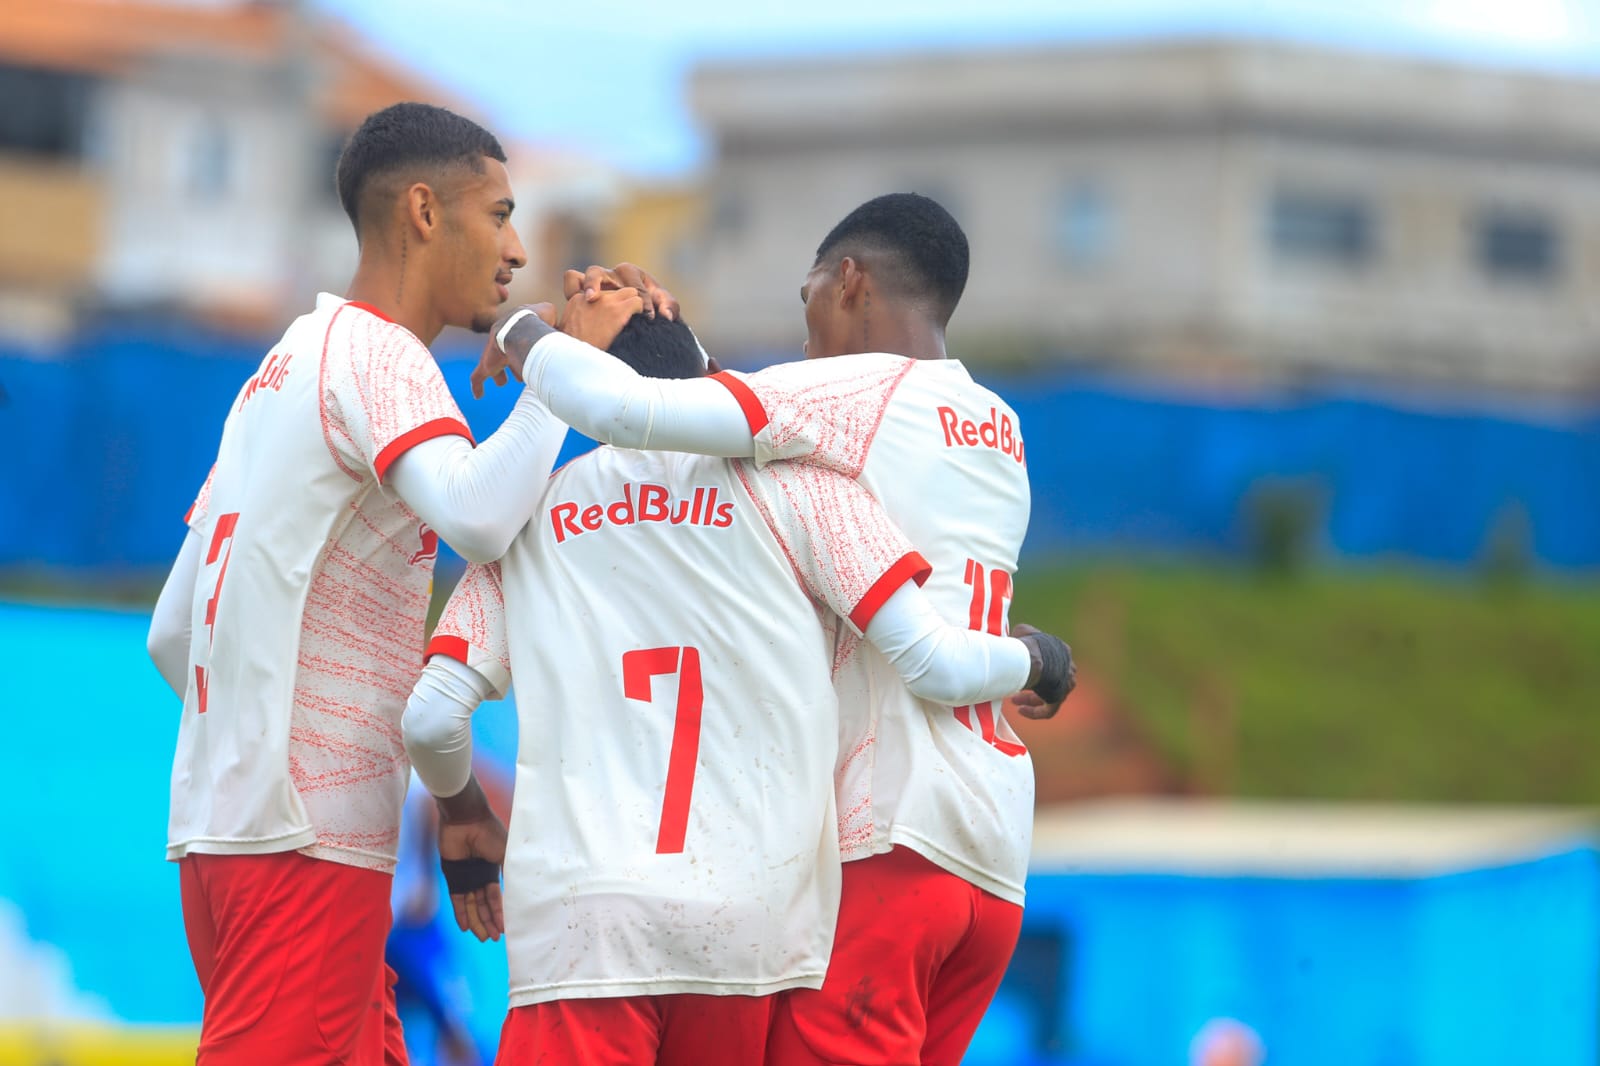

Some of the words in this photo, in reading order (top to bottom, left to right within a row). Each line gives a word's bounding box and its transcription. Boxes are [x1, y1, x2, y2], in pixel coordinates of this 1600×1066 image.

[936, 406, 1026, 467] RedBu
[550, 482, 735, 544] RedBulls
[622, 646, 704, 854] 7
